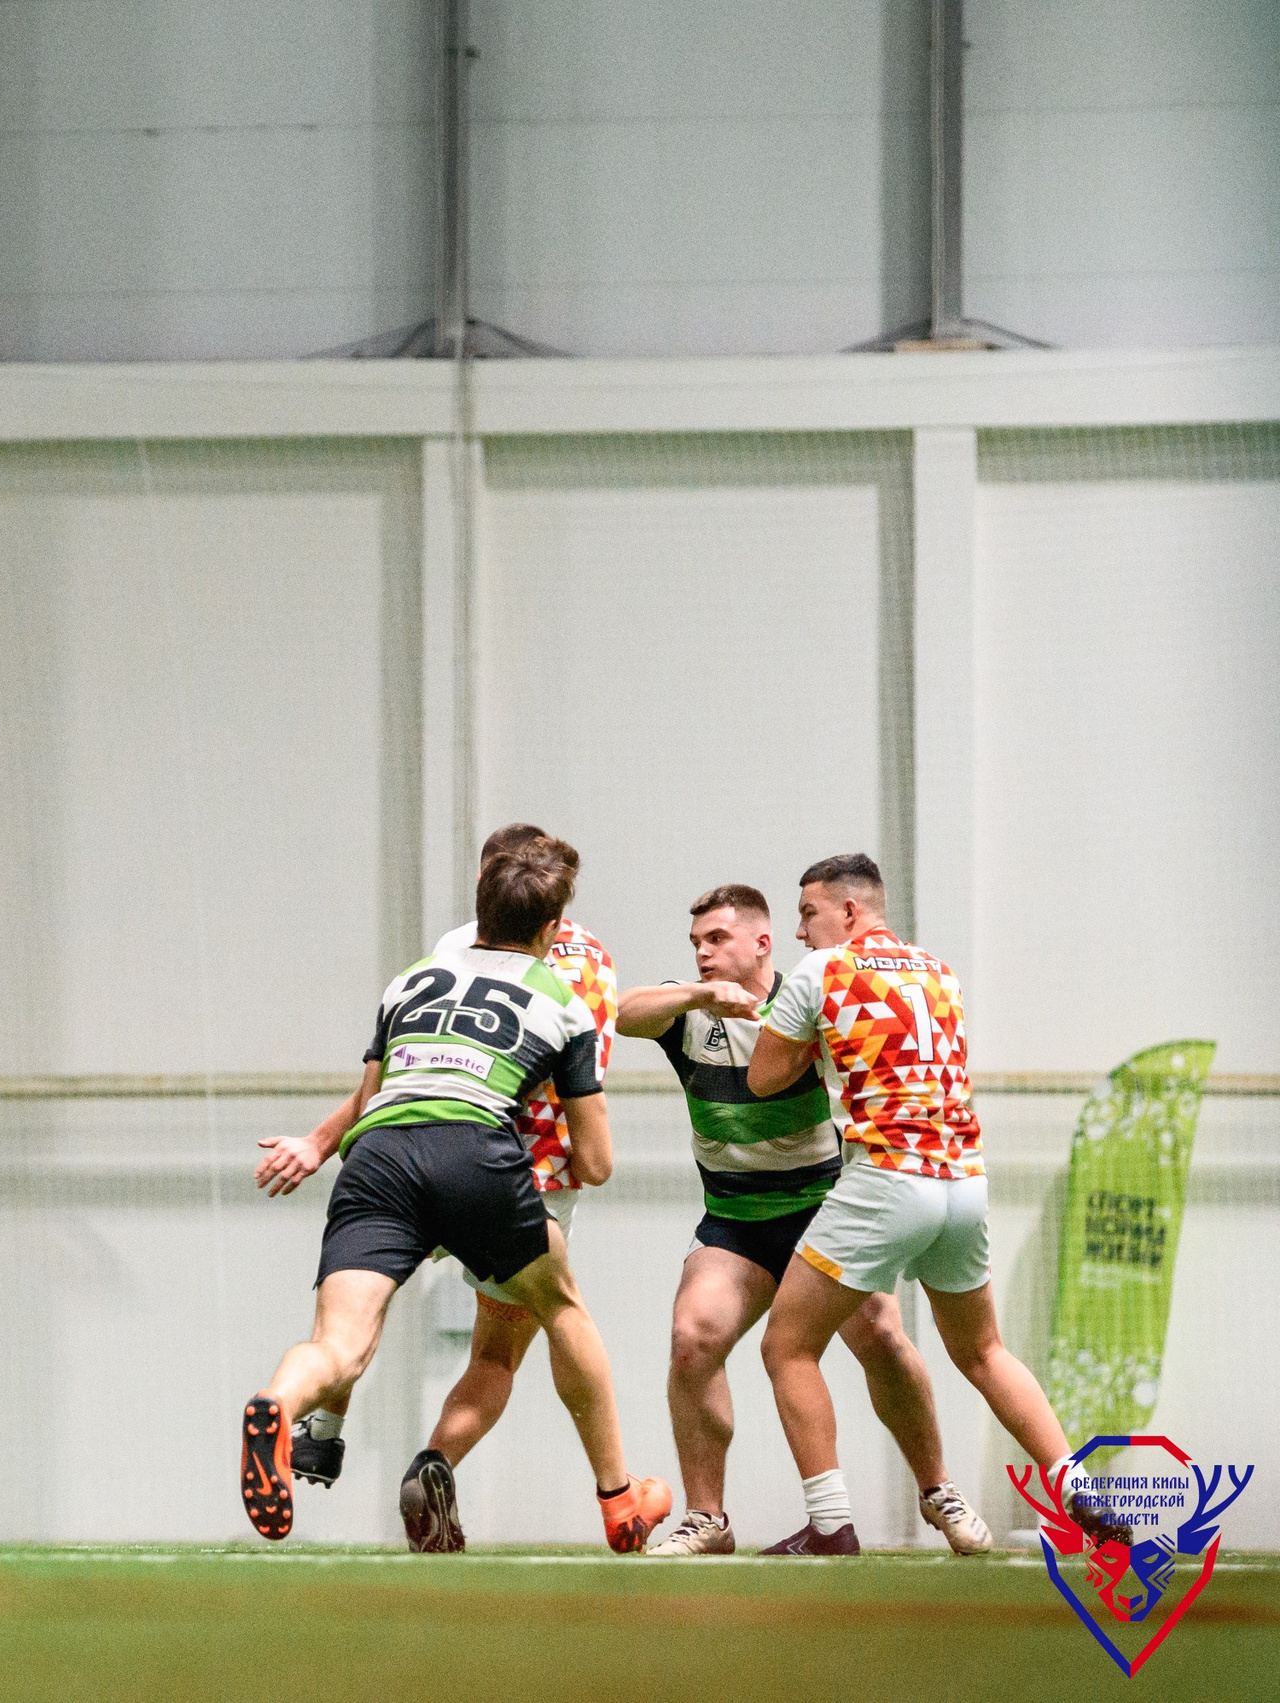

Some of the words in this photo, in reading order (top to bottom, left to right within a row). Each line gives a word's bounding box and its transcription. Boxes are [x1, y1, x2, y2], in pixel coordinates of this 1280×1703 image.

[853, 956, 941, 973] МОЛОТ
[388, 967, 534, 1053] 25
[899, 983, 934, 1062] 1
[430, 1054, 486, 1074] elastic
